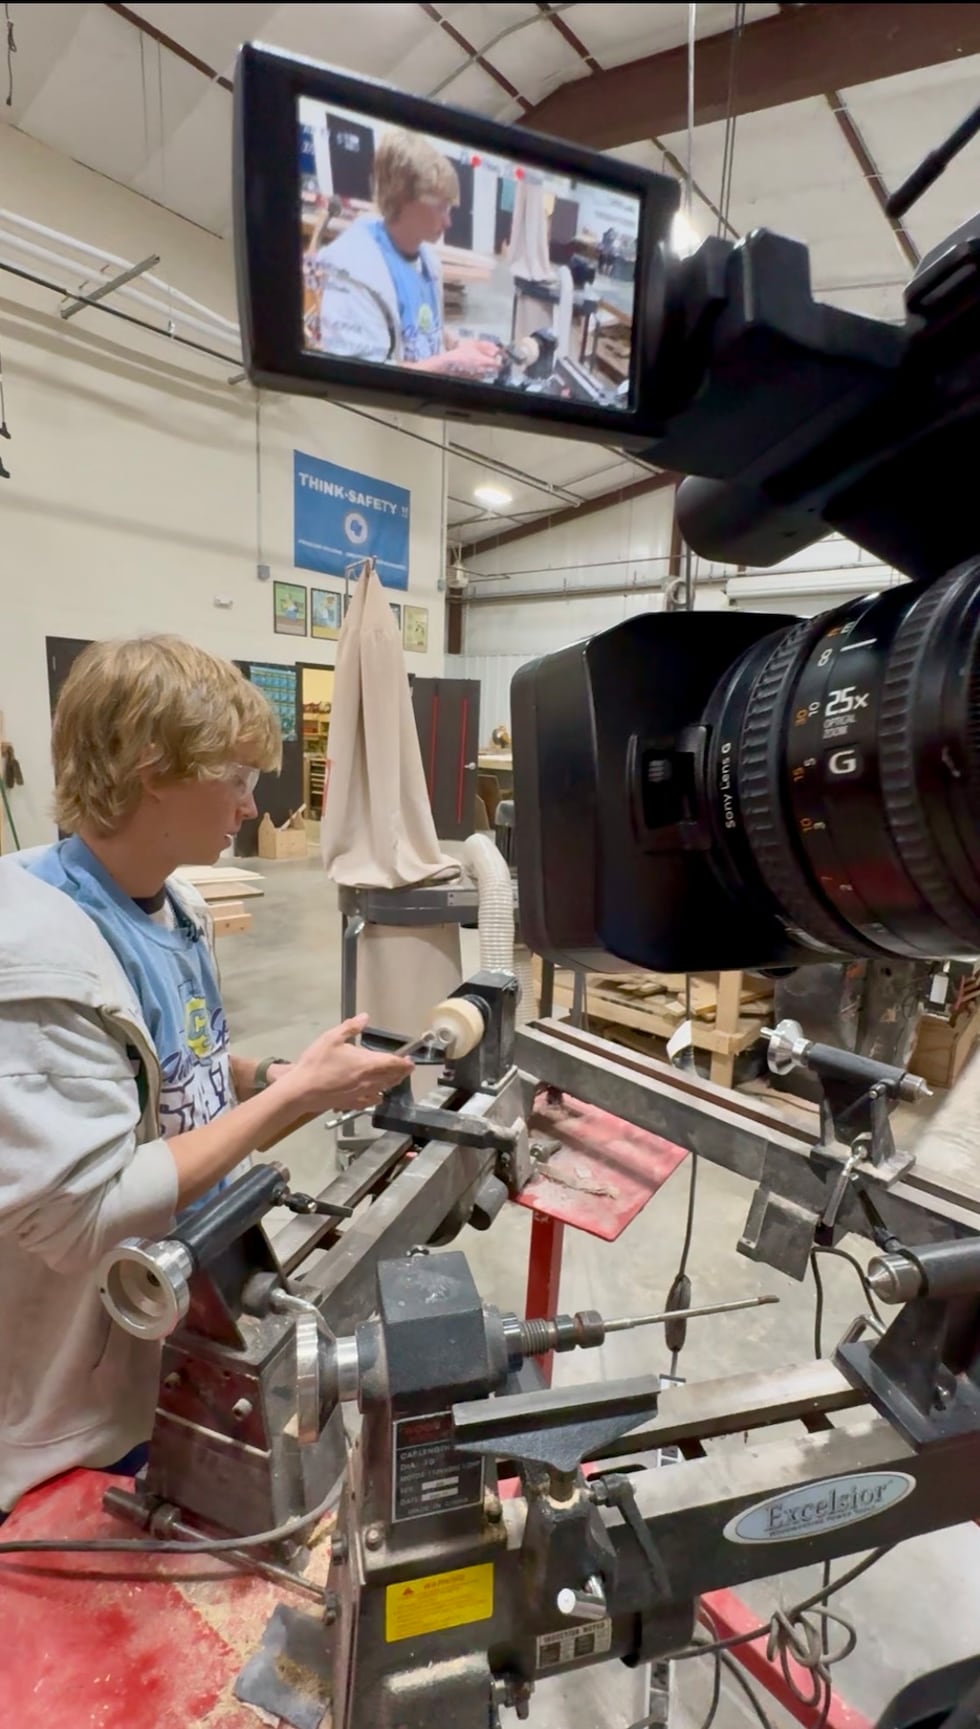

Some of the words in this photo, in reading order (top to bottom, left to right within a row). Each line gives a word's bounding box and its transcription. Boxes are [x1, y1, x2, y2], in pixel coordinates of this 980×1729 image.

[825, 686, 871, 717] 25x
[721, 757, 732, 791] Lens
[828, 749, 857, 774] G
[724, 794, 736, 829] Sony
[764, 1482, 889, 1531] Excelsior
